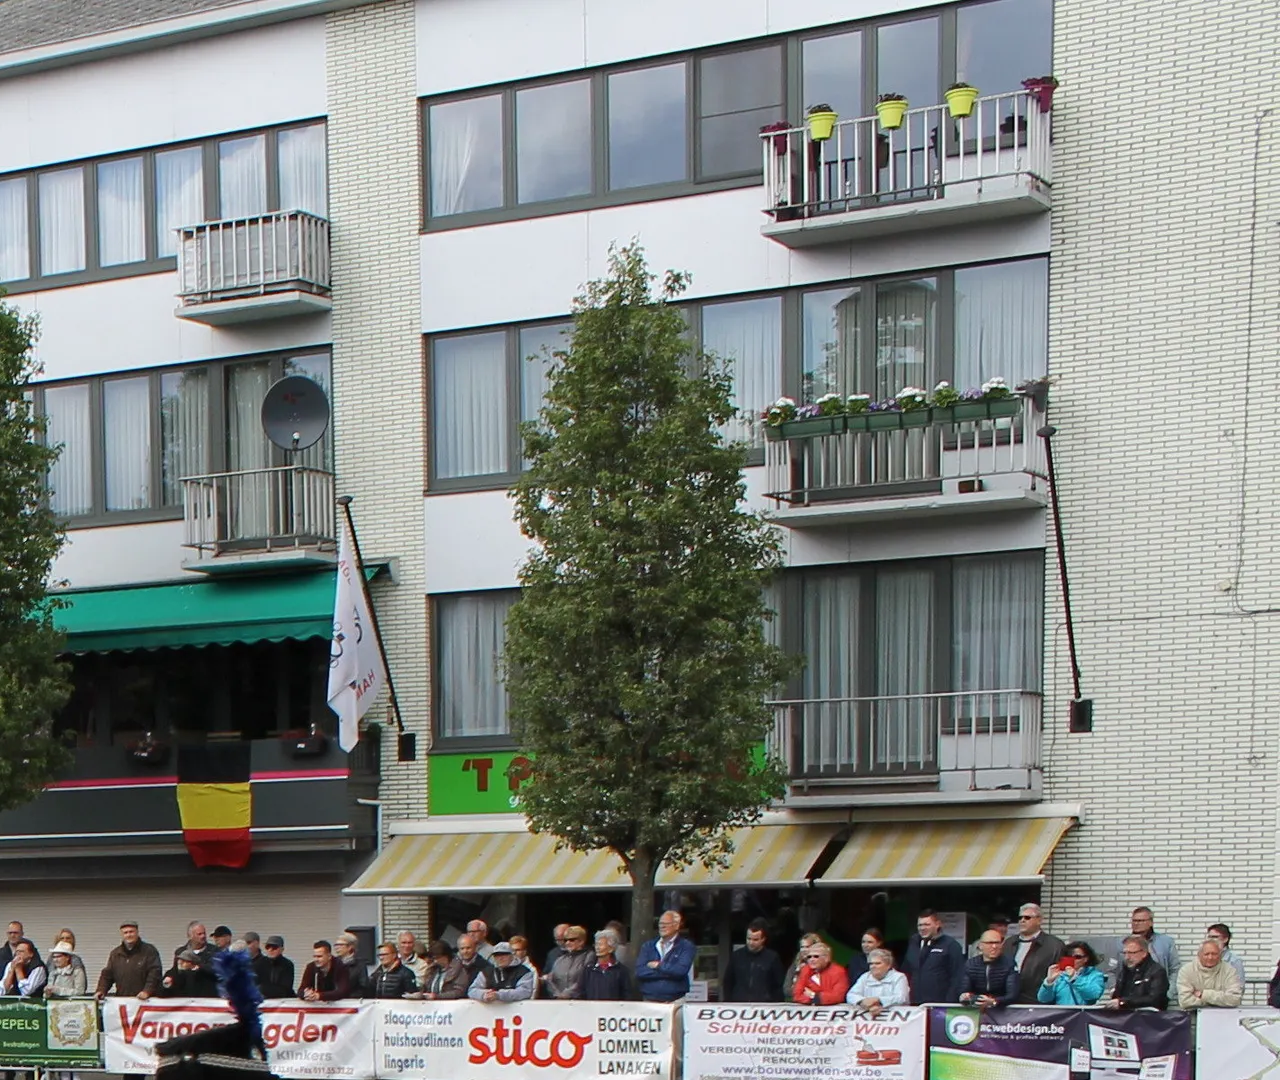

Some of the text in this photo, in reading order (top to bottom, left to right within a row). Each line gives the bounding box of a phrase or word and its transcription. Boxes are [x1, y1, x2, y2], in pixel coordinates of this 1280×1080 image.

[384, 1013, 452, 1028] slaapcomfort
[697, 1009, 911, 1021] BOUWWERKEN
[598, 1017, 663, 1033] BOCHOLT
[707, 1022, 900, 1036] Schildermans Wim
[384, 1033, 463, 1048] huishoudlinnen
[468, 1015, 592, 1068] stico
[598, 1039, 658, 1053] LOMMEL
[757, 1037, 836, 1046] NIEUWBOUW
[700, 1046, 801, 1055] VERBOUWINGEN
[384, 1055, 425, 1073] lingerie
[598, 1060, 661, 1075] LANAKEN
[762, 1056, 831, 1065] RENOVATIE
[722, 1065, 882, 1077] www.bouwwerken-sw.be
